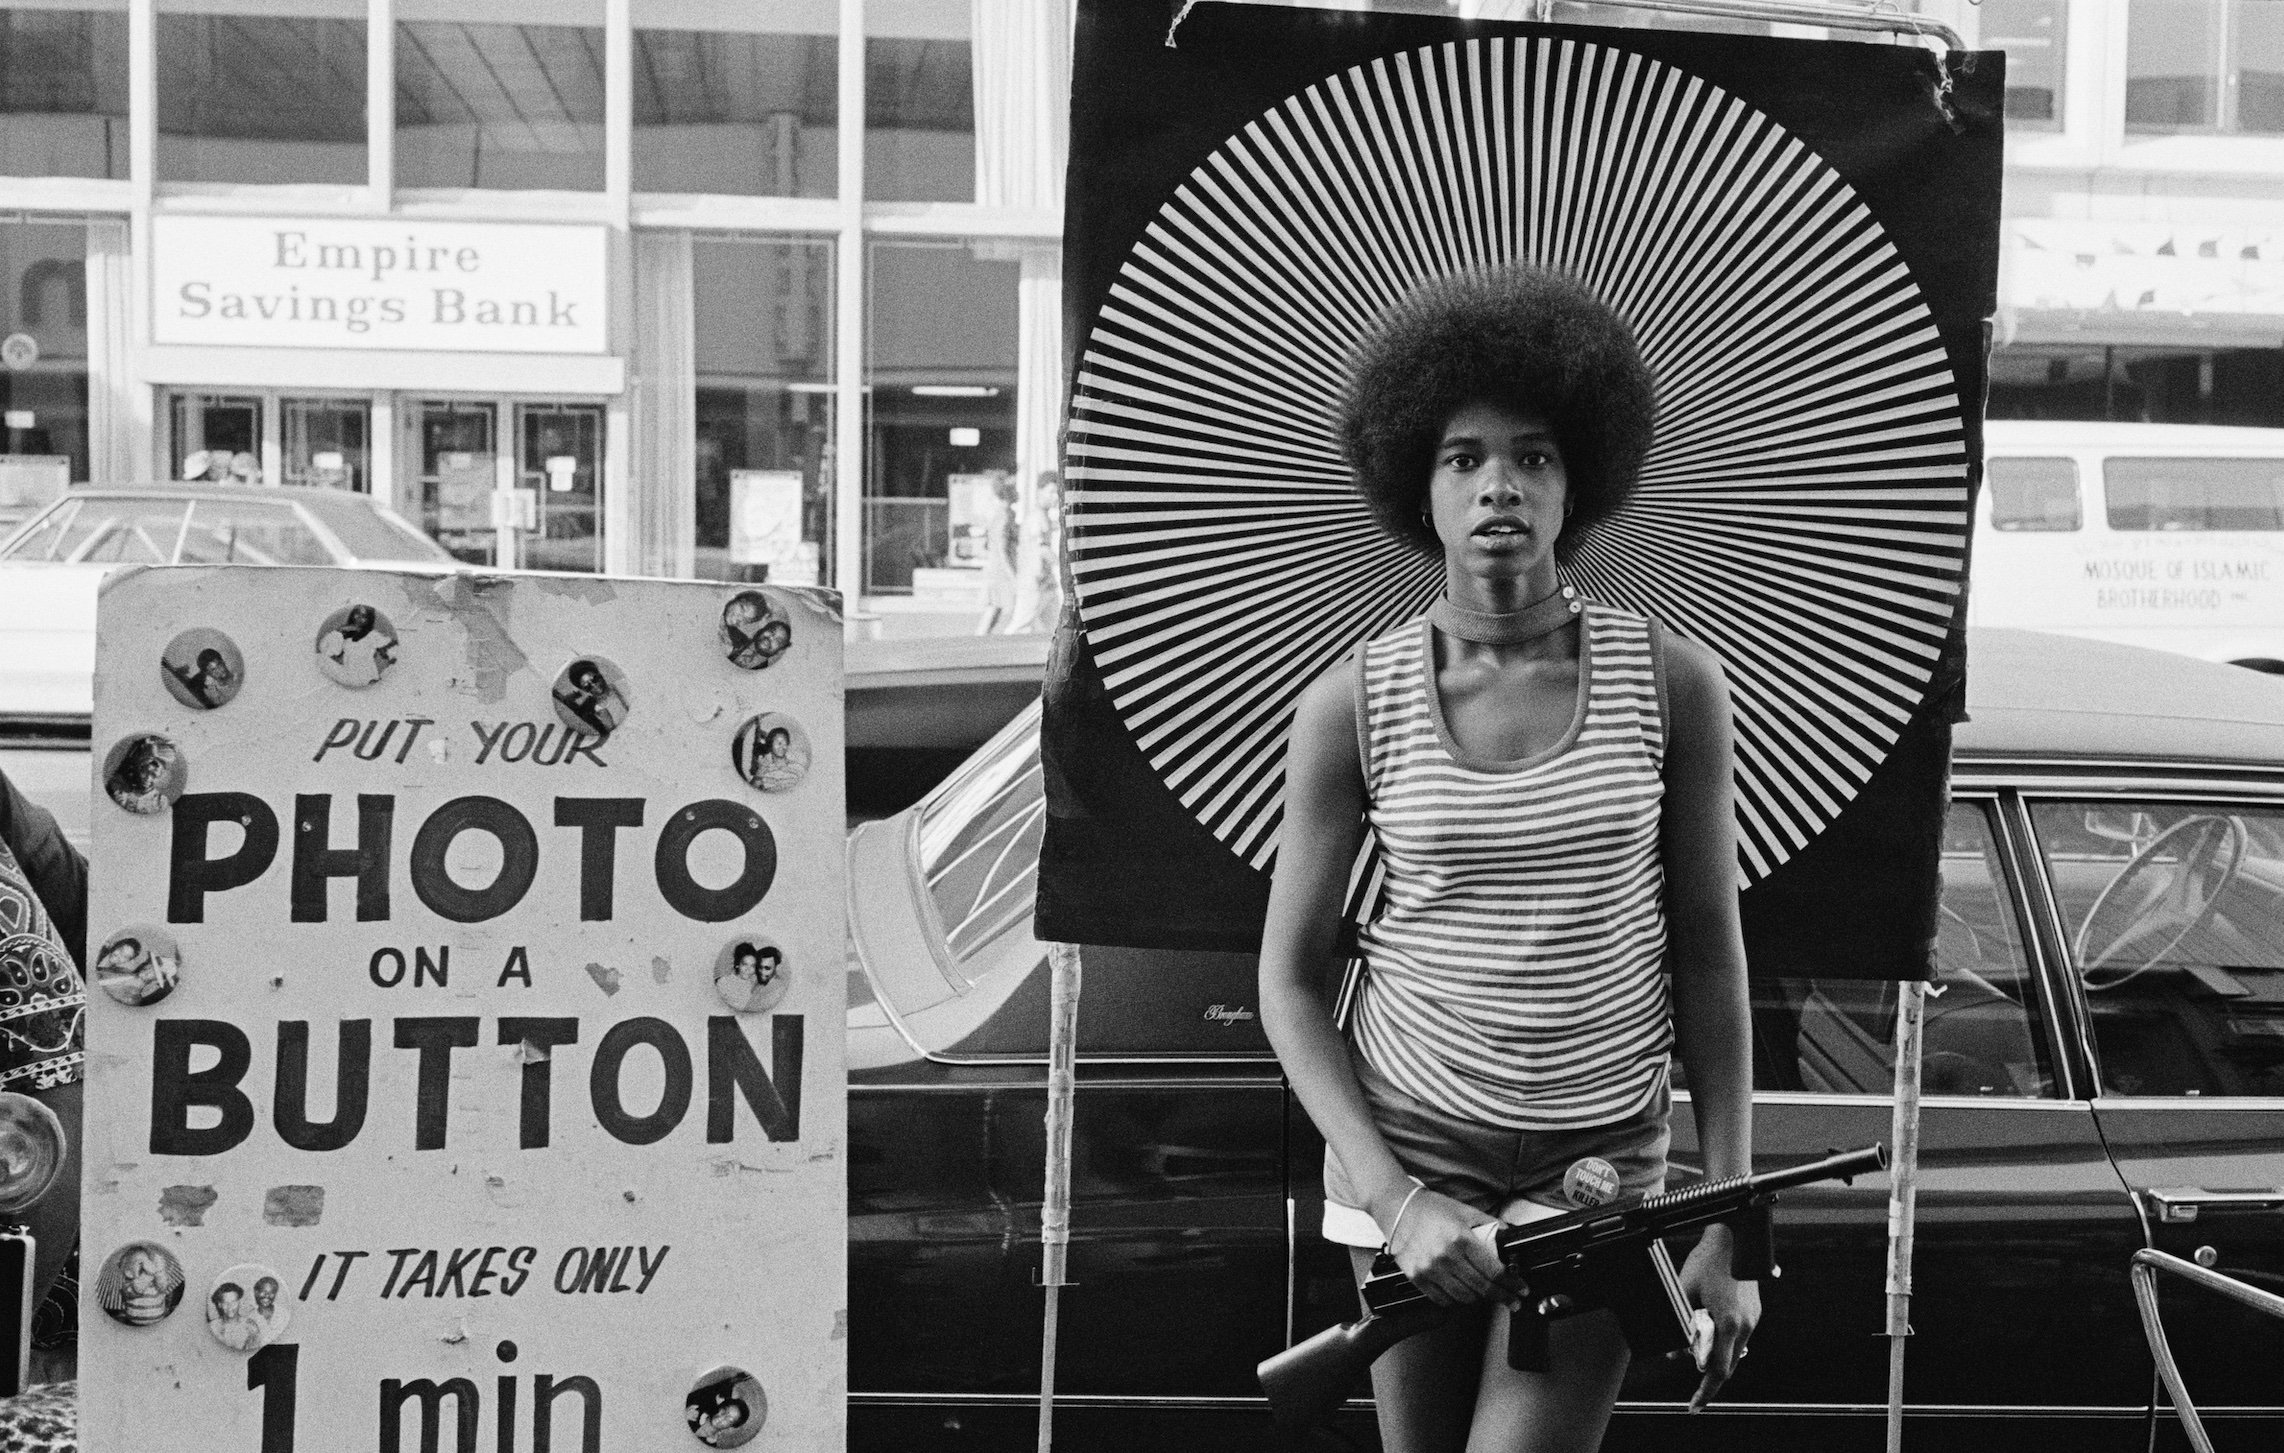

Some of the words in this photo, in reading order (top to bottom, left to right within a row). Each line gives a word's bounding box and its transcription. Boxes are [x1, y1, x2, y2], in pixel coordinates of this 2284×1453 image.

[273, 232, 480, 280] Empire
[179, 282, 406, 333] Savings
[432, 289, 580, 327] Bank
[2084, 560, 2156, 580] MOSQUE
[2167, 561, 2182, 579] OF
[2193, 560, 2270, 580] ISLAMIC
[2097, 588, 2221, 609] BROTHERHOOD
[312, 717, 435, 763] PUT
[470, 720, 609, 767] YOUR
[168, 793, 778, 924] PHOTO
[369, 945, 449, 988] ON
[497, 946, 533, 988] A
[149, 1016, 804, 1156] BUTTON
[1576, 1167, 1602, 1189] TOUCH
[1600, 1180, 1615, 1194] ME
[1586, 1160, 1611, 1178] DON'T
[299, 1250, 370, 1302] IT
[380, 1246, 538, 1300] TAKES
[554, 1244, 671, 1296] ONLY
[247, 1343, 300, 1453] 1
[379, 1340, 603, 1453] min
